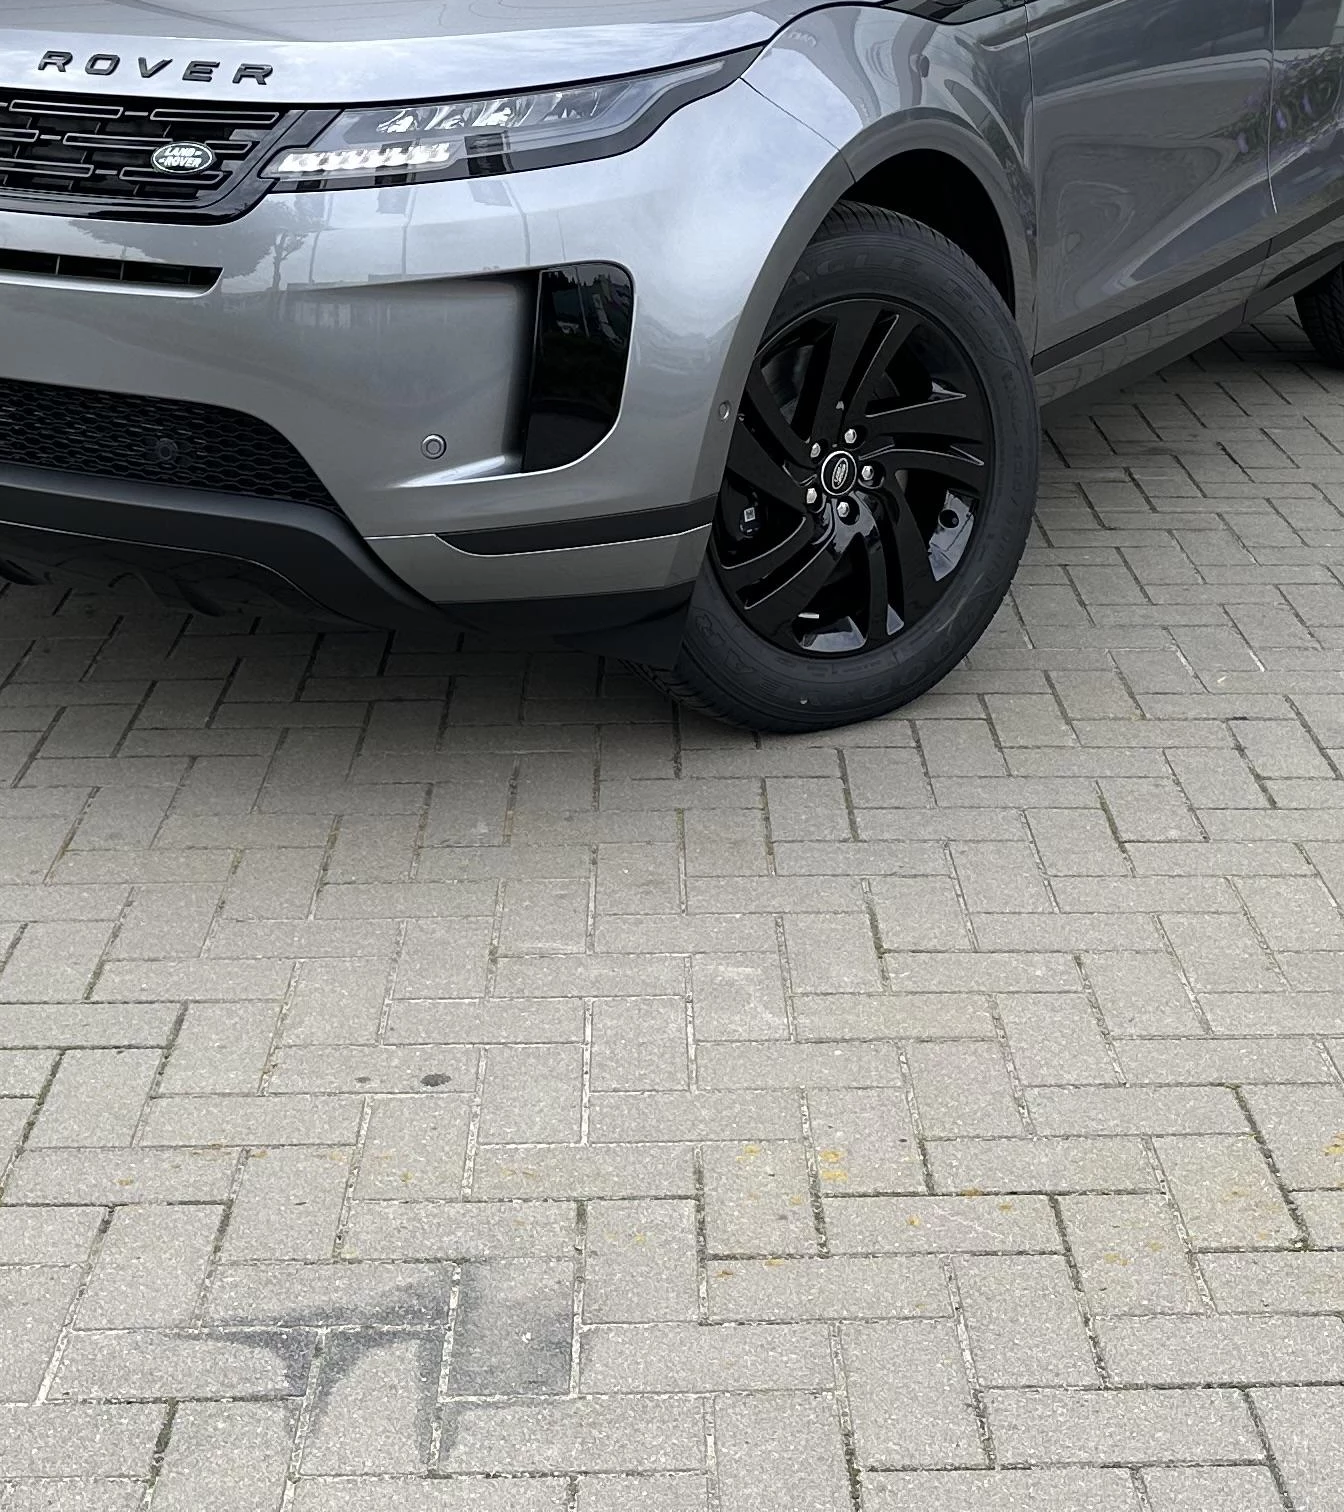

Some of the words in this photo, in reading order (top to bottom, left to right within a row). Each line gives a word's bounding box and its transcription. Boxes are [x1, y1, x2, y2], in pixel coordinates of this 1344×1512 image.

[37, 49, 276, 86] ROVER
[164, 146, 196, 157] LAND
[163, 156, 203, 168] ROVER
